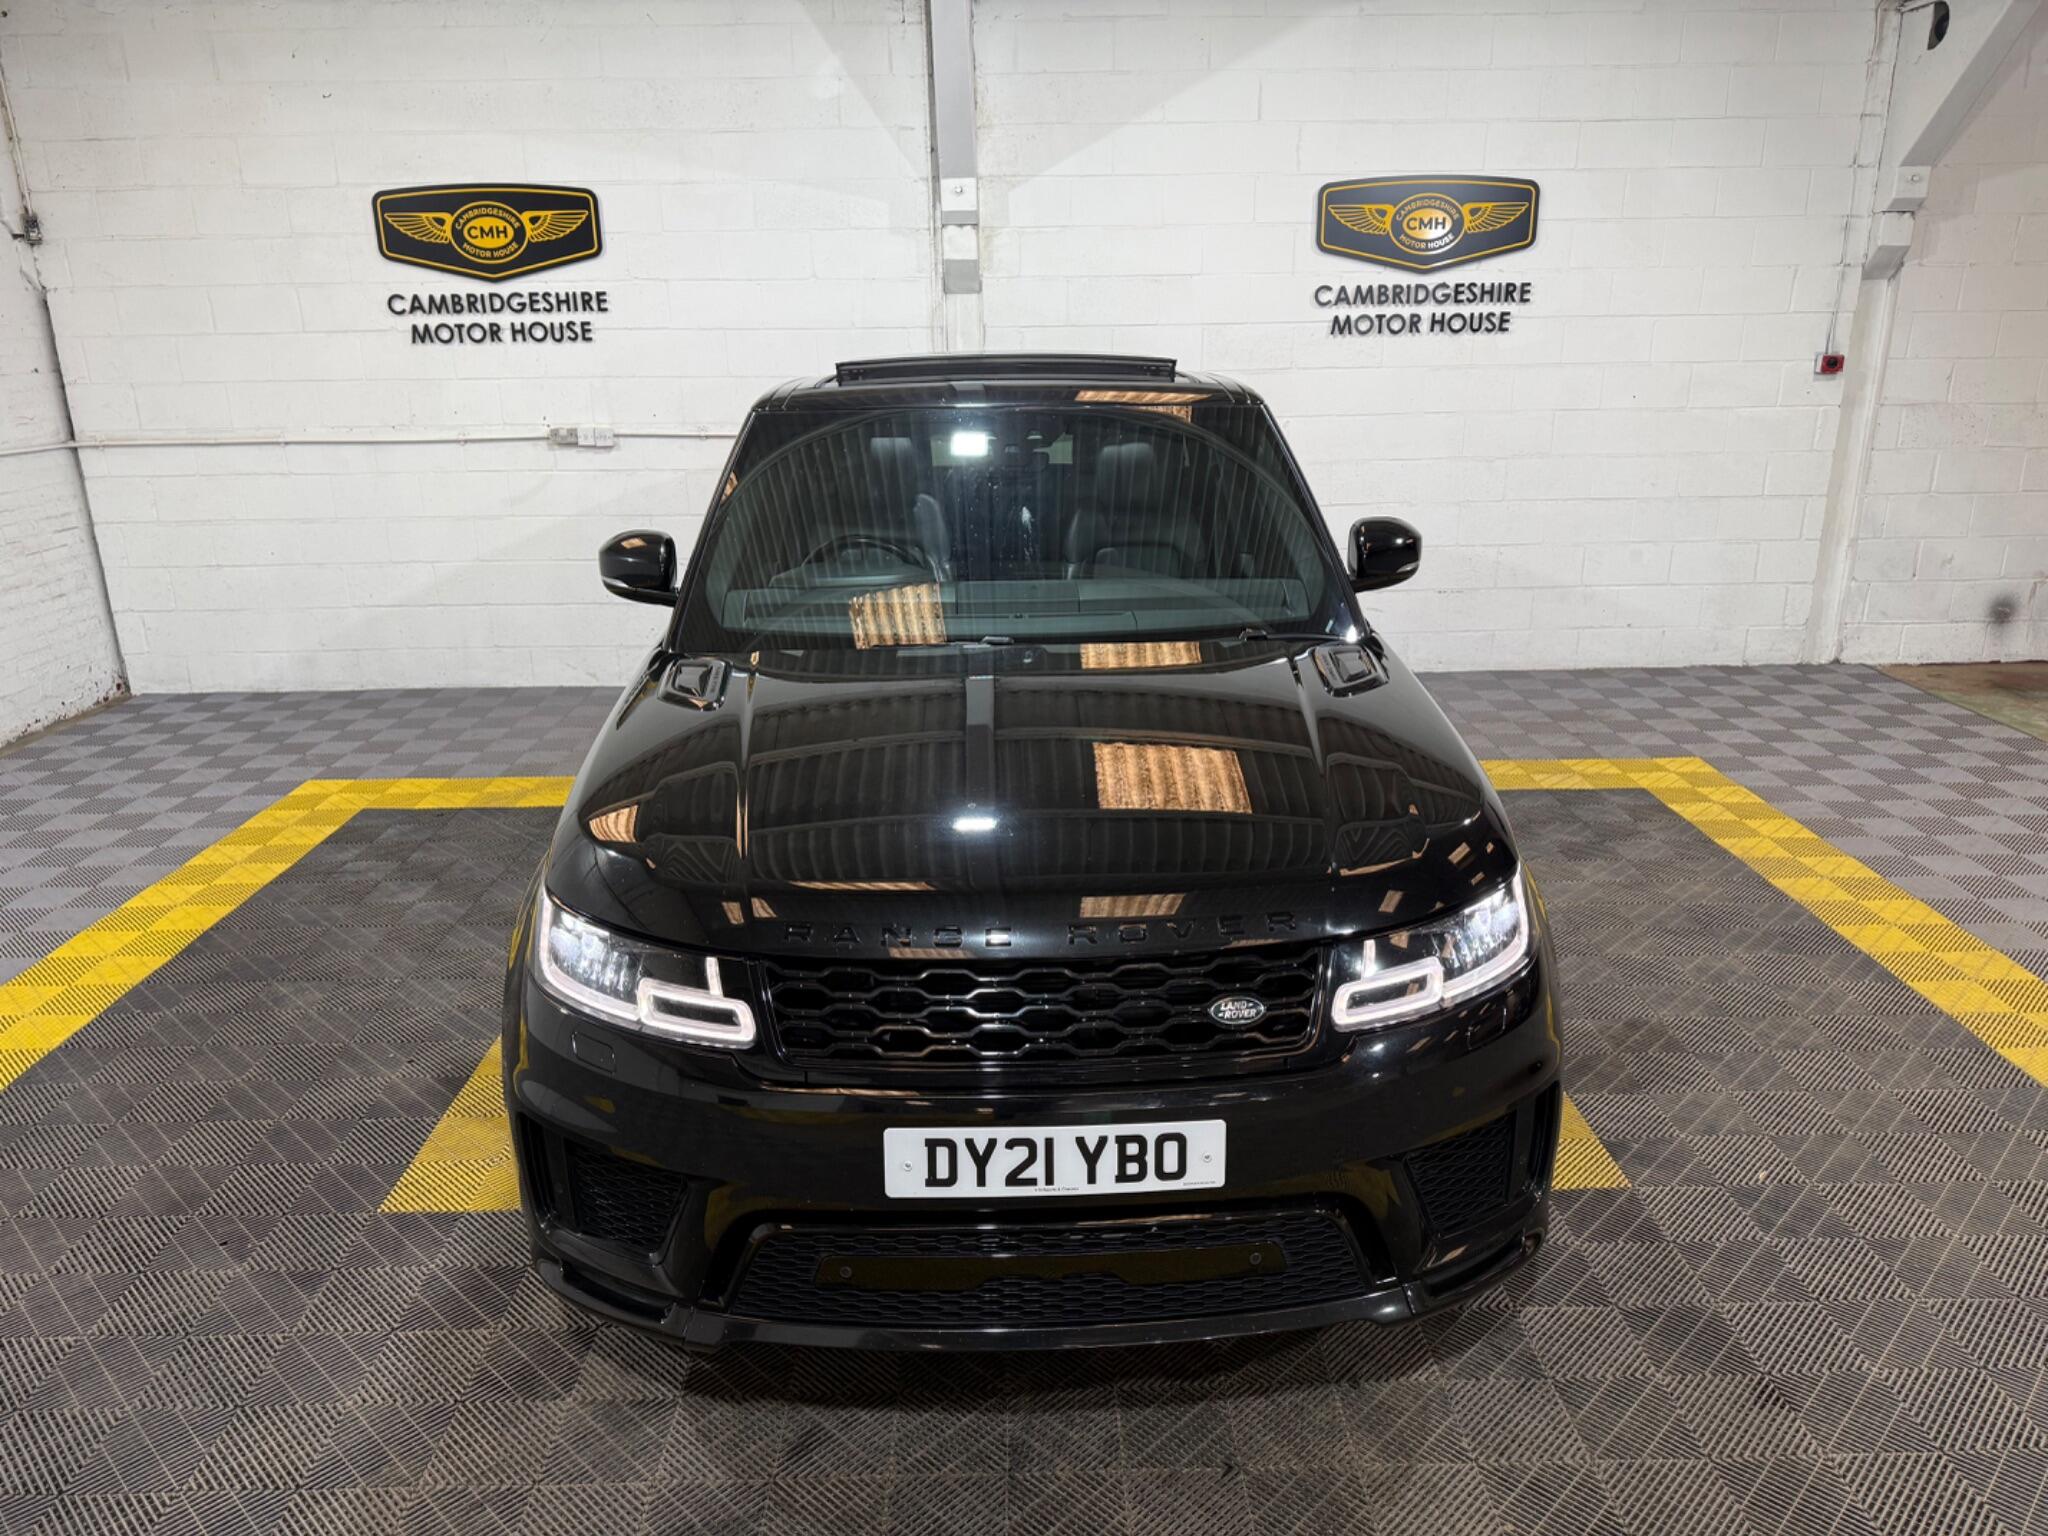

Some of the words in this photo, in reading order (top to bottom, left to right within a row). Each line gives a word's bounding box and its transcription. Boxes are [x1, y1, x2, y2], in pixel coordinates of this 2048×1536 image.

[456, 207, 521, 230] CAMBRIDGESHIRE
[1396, 199, 1459, 221] CAMBRIDGESHIRE
[467, 225, 508, 239] CMH
[1406, 217, 1446, 231] CMH
[463, 242, 492, 258] MOTOR
[493, 241, 519, 258] HOUSE
[1400, 233, 1426, 249] MOTOR
[1427, 232, 1455, 249] HOUSE
[387, 291, 609, 315] CAMBRIDGESHIRE
[1314, 282, 1532, 307] CAMBRIDGESHIRE
[411, 322, 502, 344] MOTOR
[510, 321, 593, 343] HOUSE
[1330, 313, 1421, 335] MOTOR
[1429, 311, 1512, 333] HOUSE
[785, 923, 1012, 947] RANGE
[1067, 911, 1297, 945] ROVER
[924, 1137, 1054, 1187] DY21
[1075, 1132, 1187, 1185] YBO
